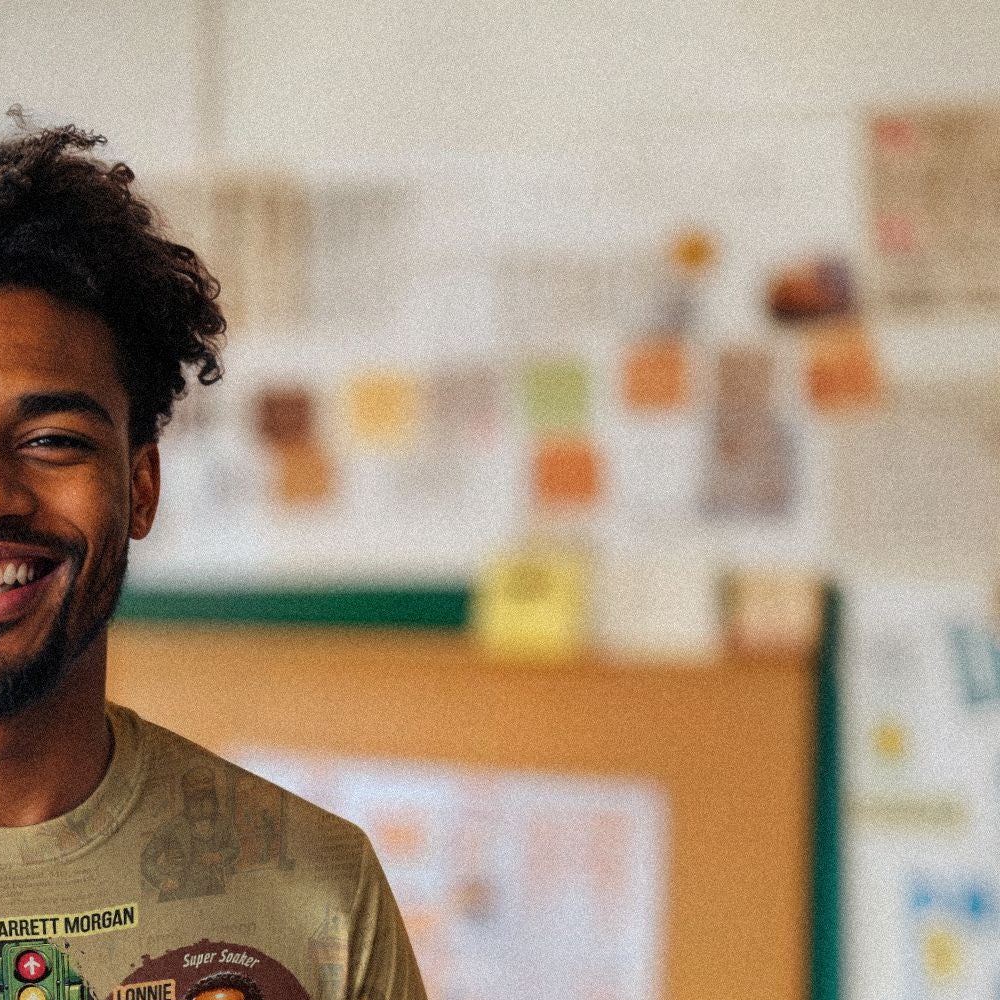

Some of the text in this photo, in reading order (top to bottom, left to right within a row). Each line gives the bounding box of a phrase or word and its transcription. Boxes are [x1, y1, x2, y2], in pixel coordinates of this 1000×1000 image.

[64, 907, 135, 934] MORGAN
[183, 949, 260, 968] Super Soaker
